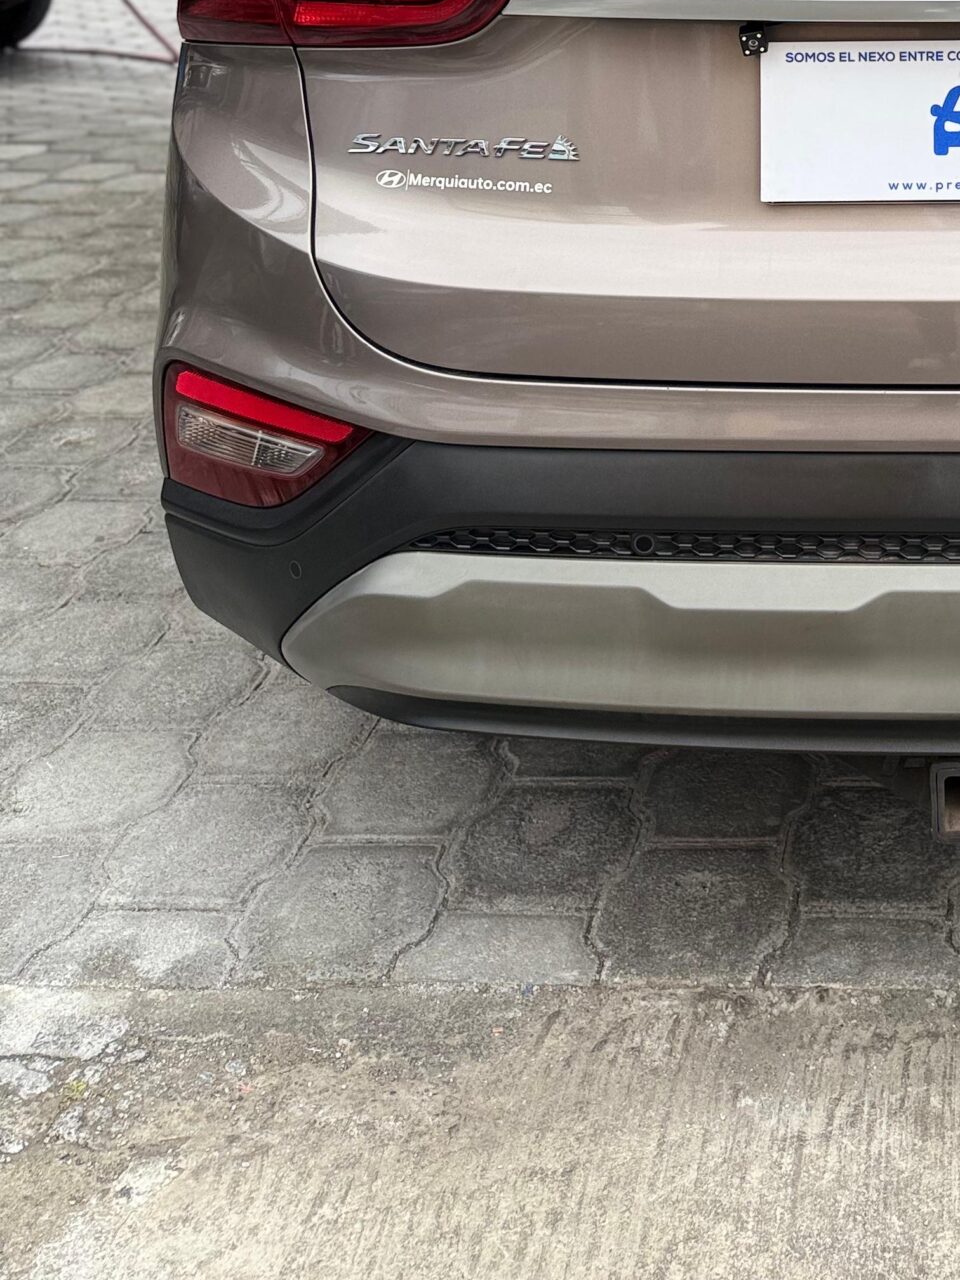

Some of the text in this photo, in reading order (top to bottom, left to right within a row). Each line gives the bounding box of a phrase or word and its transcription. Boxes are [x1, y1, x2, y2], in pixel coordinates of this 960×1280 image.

[785, 51, 836, 63] SOMOS
[838, 51, 855, 63] EL
[857, 50, 896, 63] NEXO
[898, 50, 944, 62] ENTRE
[408, 172, 553, 194] Merquiauto.com.ec
